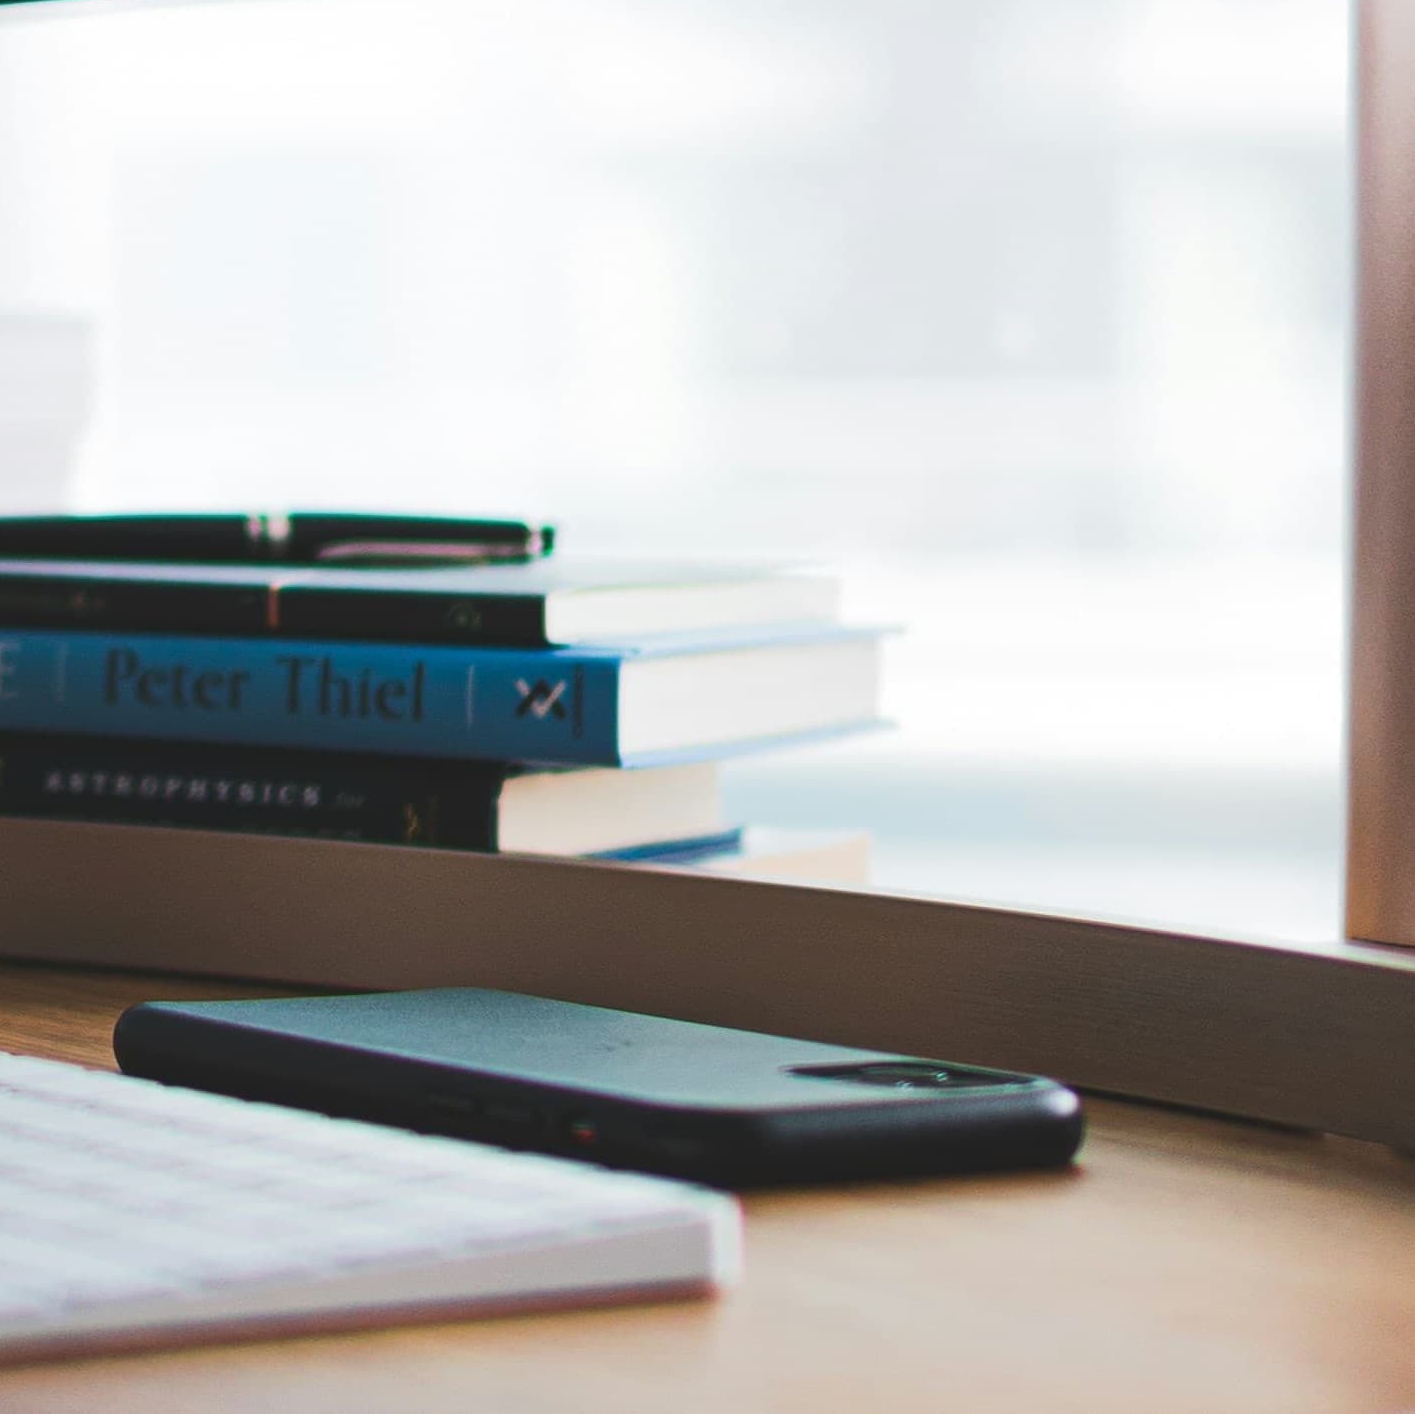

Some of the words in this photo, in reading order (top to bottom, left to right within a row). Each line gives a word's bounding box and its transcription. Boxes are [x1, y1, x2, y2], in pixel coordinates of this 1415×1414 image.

[103, 646, 250, 710] Peter
[275, 653, 426, 722] Thiel
[43, 770, 325, 808] ASTROPHYSICS
